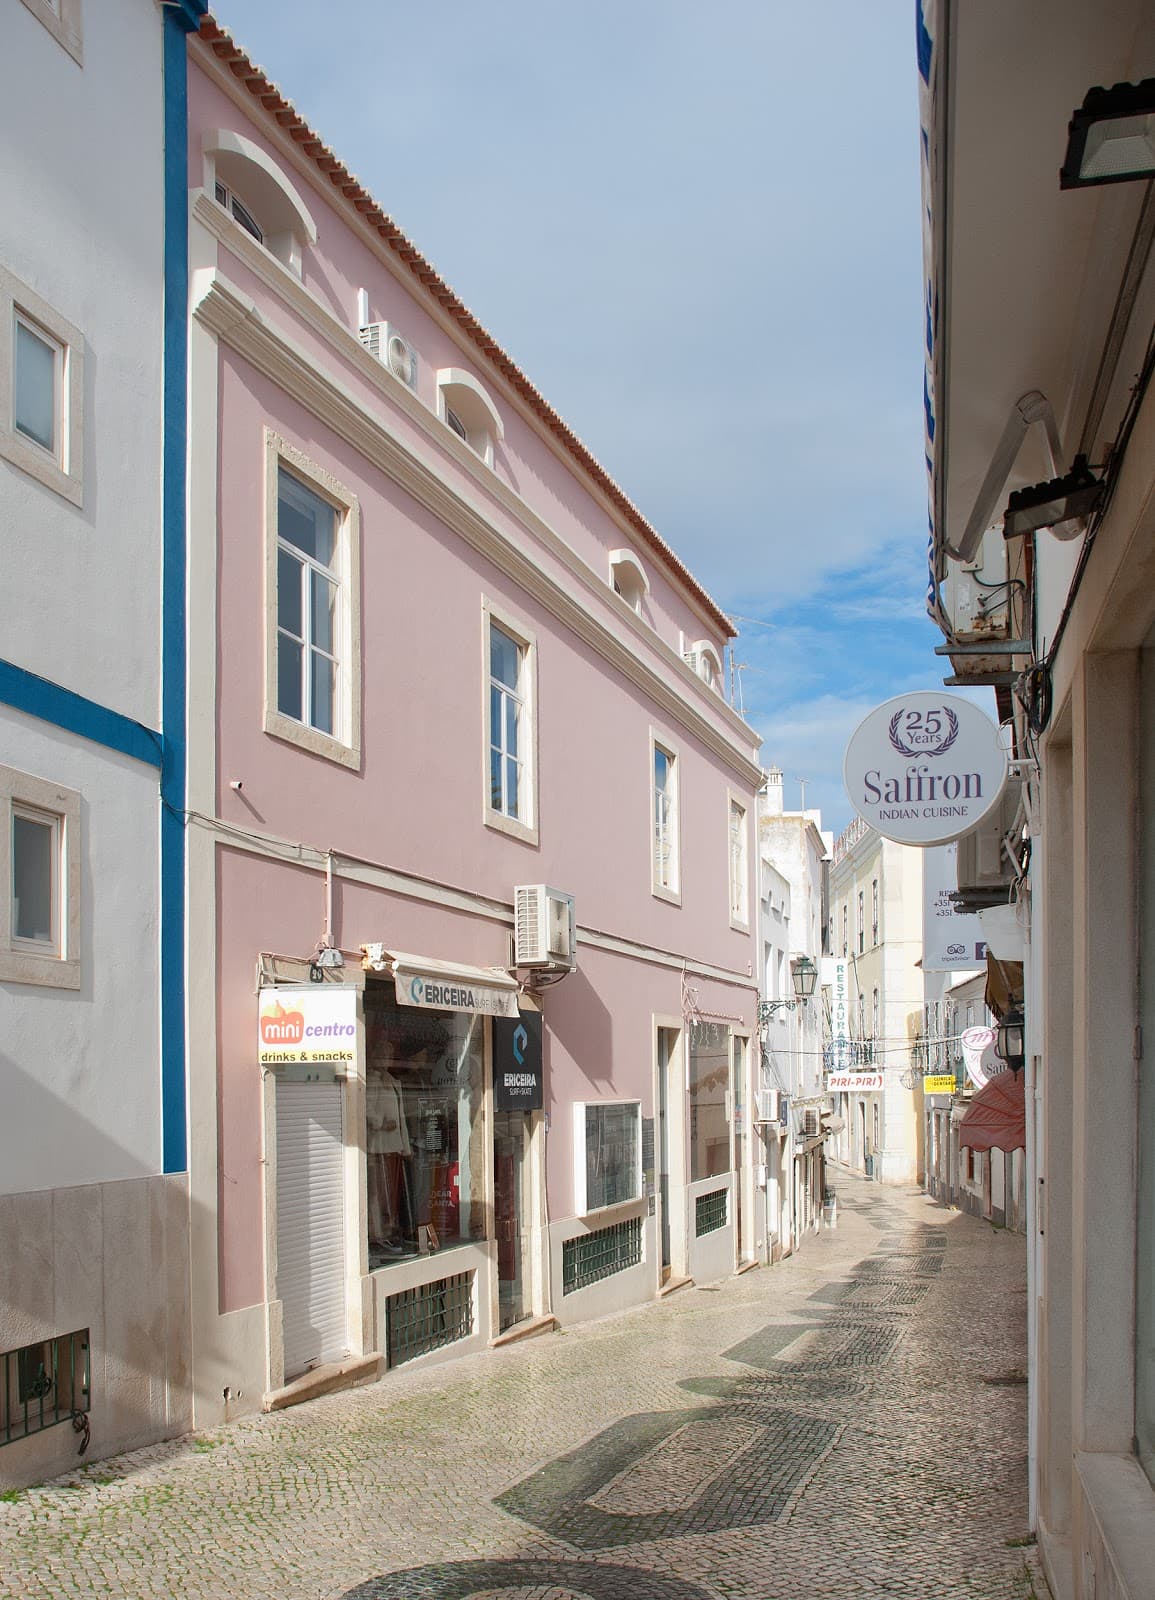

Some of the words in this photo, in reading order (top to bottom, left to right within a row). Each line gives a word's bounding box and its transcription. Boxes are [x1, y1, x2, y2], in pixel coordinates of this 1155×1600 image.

[906, 711, 941, 734] 25
[907, 732, 942, 744] Years
[864, 765, 984, 805] Saffron
[880, 809, 919, 820] INDIAN
[923, 806, 968, 818] CUISINE
[424, 985, 475, 1008] ERICEIRA
[265, 1020, 300, 1039] mini
[305, 1022, 355, 1037] centro
[261, 1052, 296, 1062] drinks
[300, 1052, 308, 1060] &
[312, 1051, 353, 1061] snacks
[504, 1073, 537, 1086] ERICEIRA
[830, 1077, 876, 1087] PIRI-PIRI
